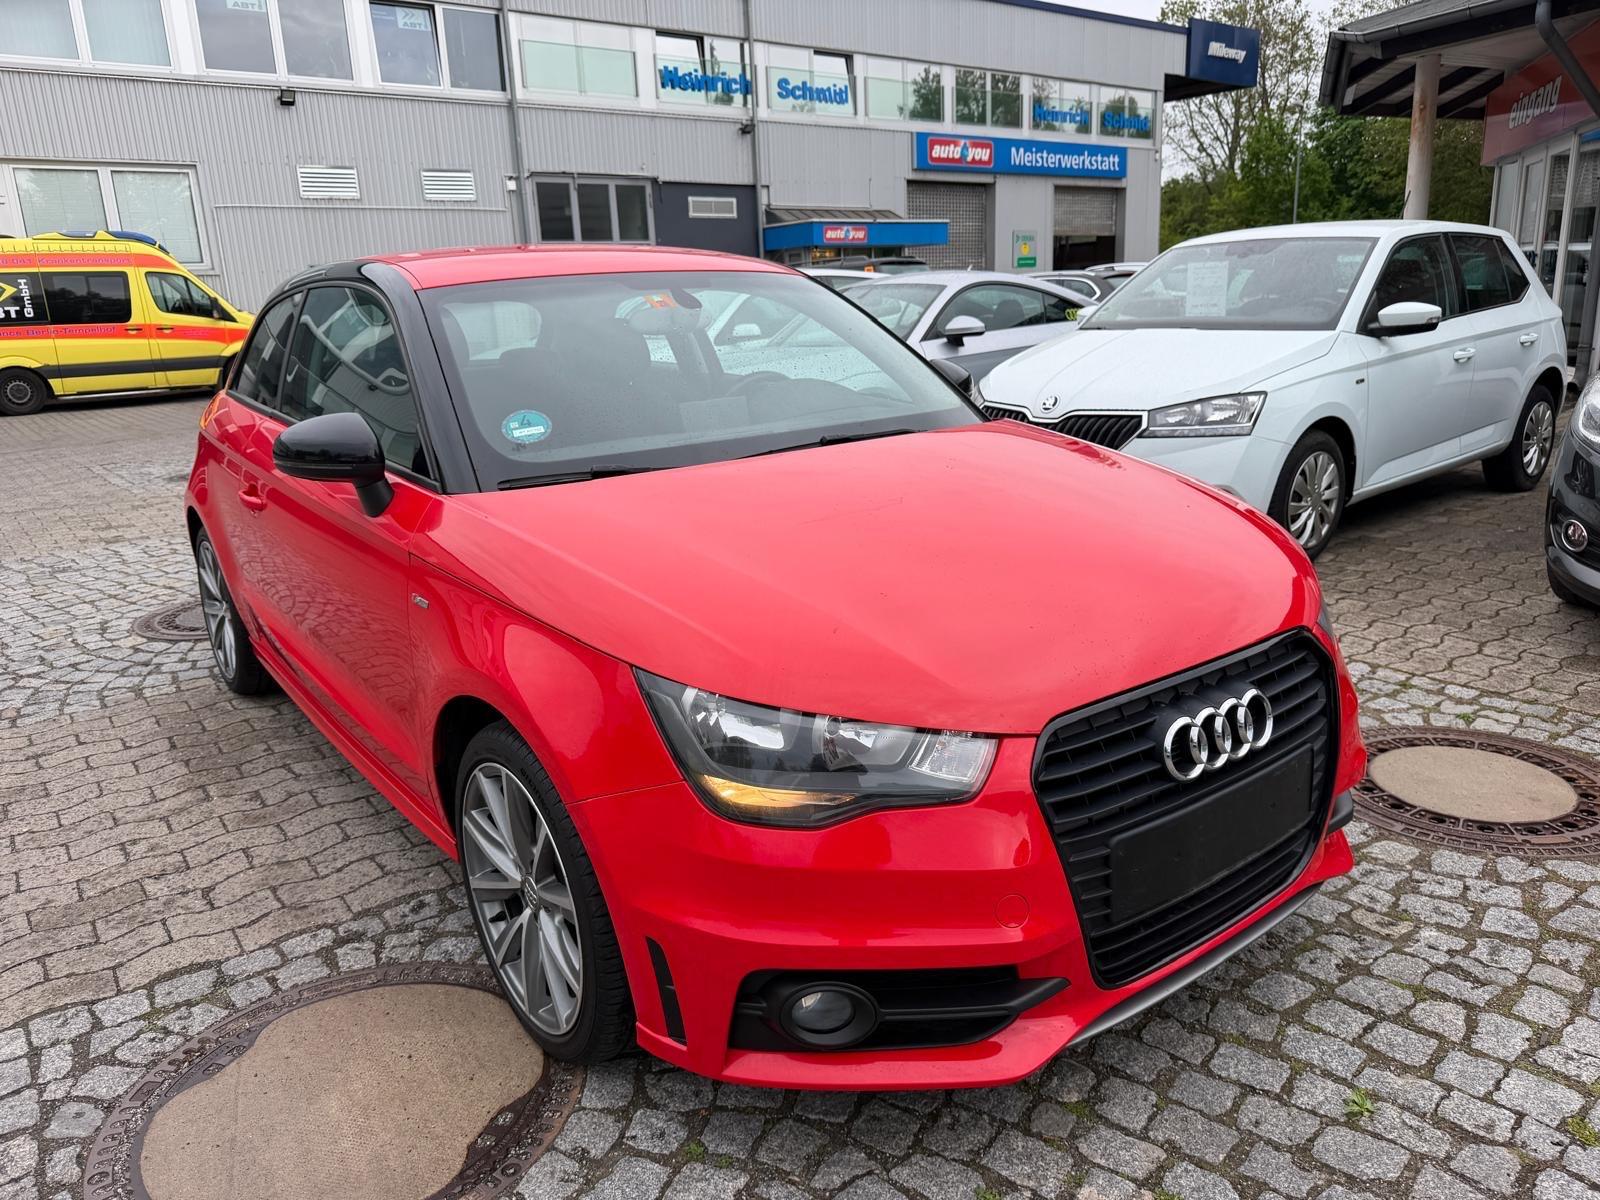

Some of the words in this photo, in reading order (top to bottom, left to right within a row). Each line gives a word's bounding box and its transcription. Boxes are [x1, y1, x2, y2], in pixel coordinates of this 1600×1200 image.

[1208, 41, 1246, 63] Mileway
[660, 65, 751, 95] Heinrich
[1509, 75, 1562, 129] eingang
[1010, 146, 1119, 171] Meisterwerkstatt
[17, 279, 34, 318] GmbH
